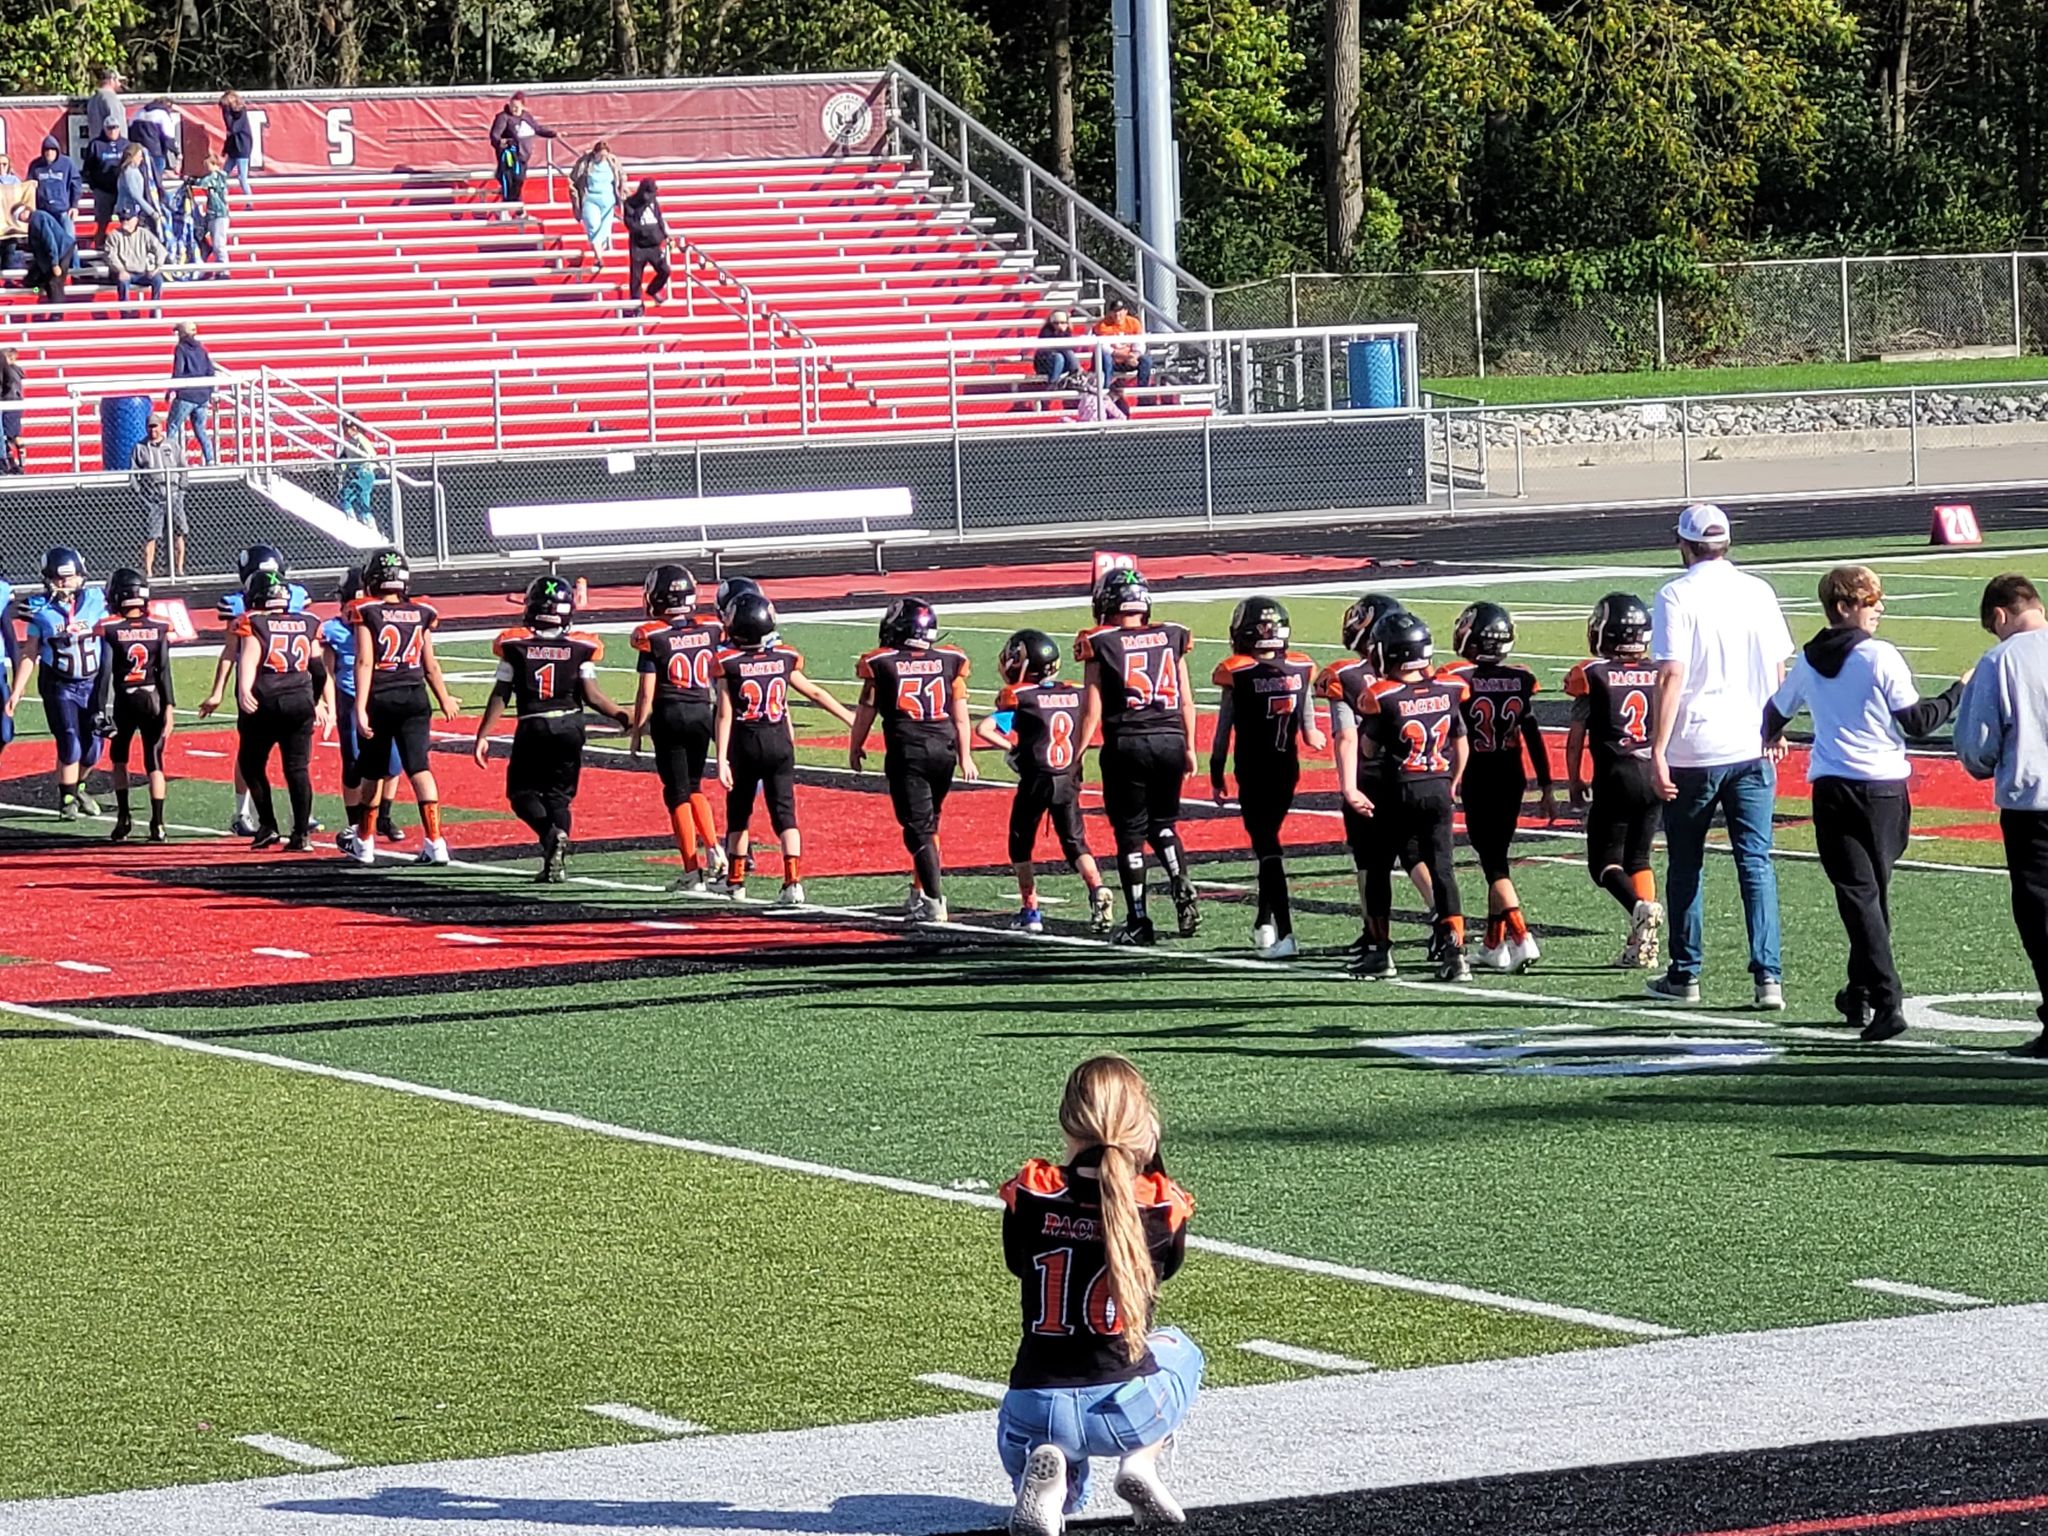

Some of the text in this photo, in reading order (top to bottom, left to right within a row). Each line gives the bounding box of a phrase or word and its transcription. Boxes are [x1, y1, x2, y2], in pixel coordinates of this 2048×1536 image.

[1941, 508, 1980, 541] 20
[124, 643, 148, 681] 2
[375, 624, 425, 670] 24
[534, 663, 555, 700] 1
[896, 677, 949, 720] 51
[1124, 647, 1179, 710] 54
[1047, 711, 1074, 769] 8
[1266, 694, 1298, 752] 7
[1398, 714, 1452, 772] 21
